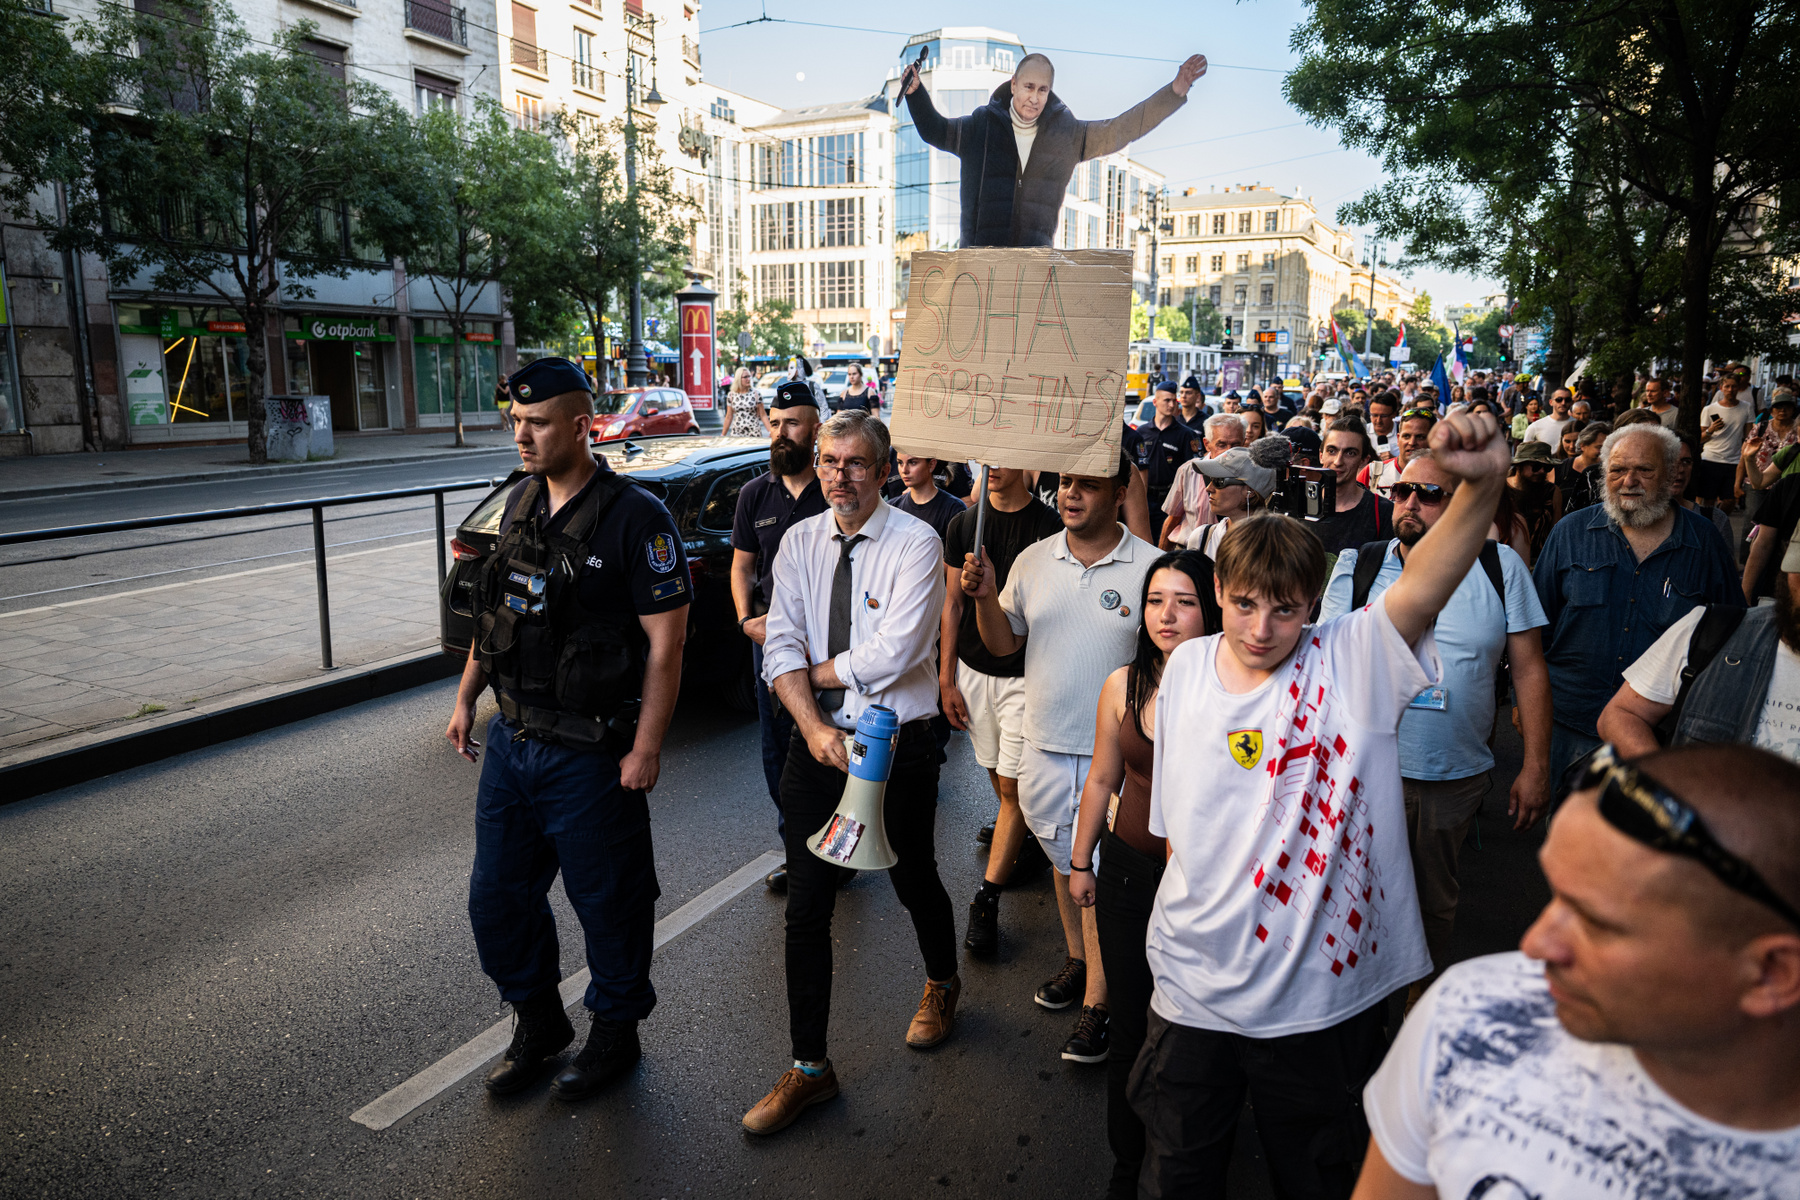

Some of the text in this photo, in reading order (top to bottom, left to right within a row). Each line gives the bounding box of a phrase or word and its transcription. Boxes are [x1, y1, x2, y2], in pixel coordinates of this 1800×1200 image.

[328, 322, 377, 340] otpbank
[914, 265, 1079, 362] SOHA
[903, 359, 1024, 429] TÖBBÉ
